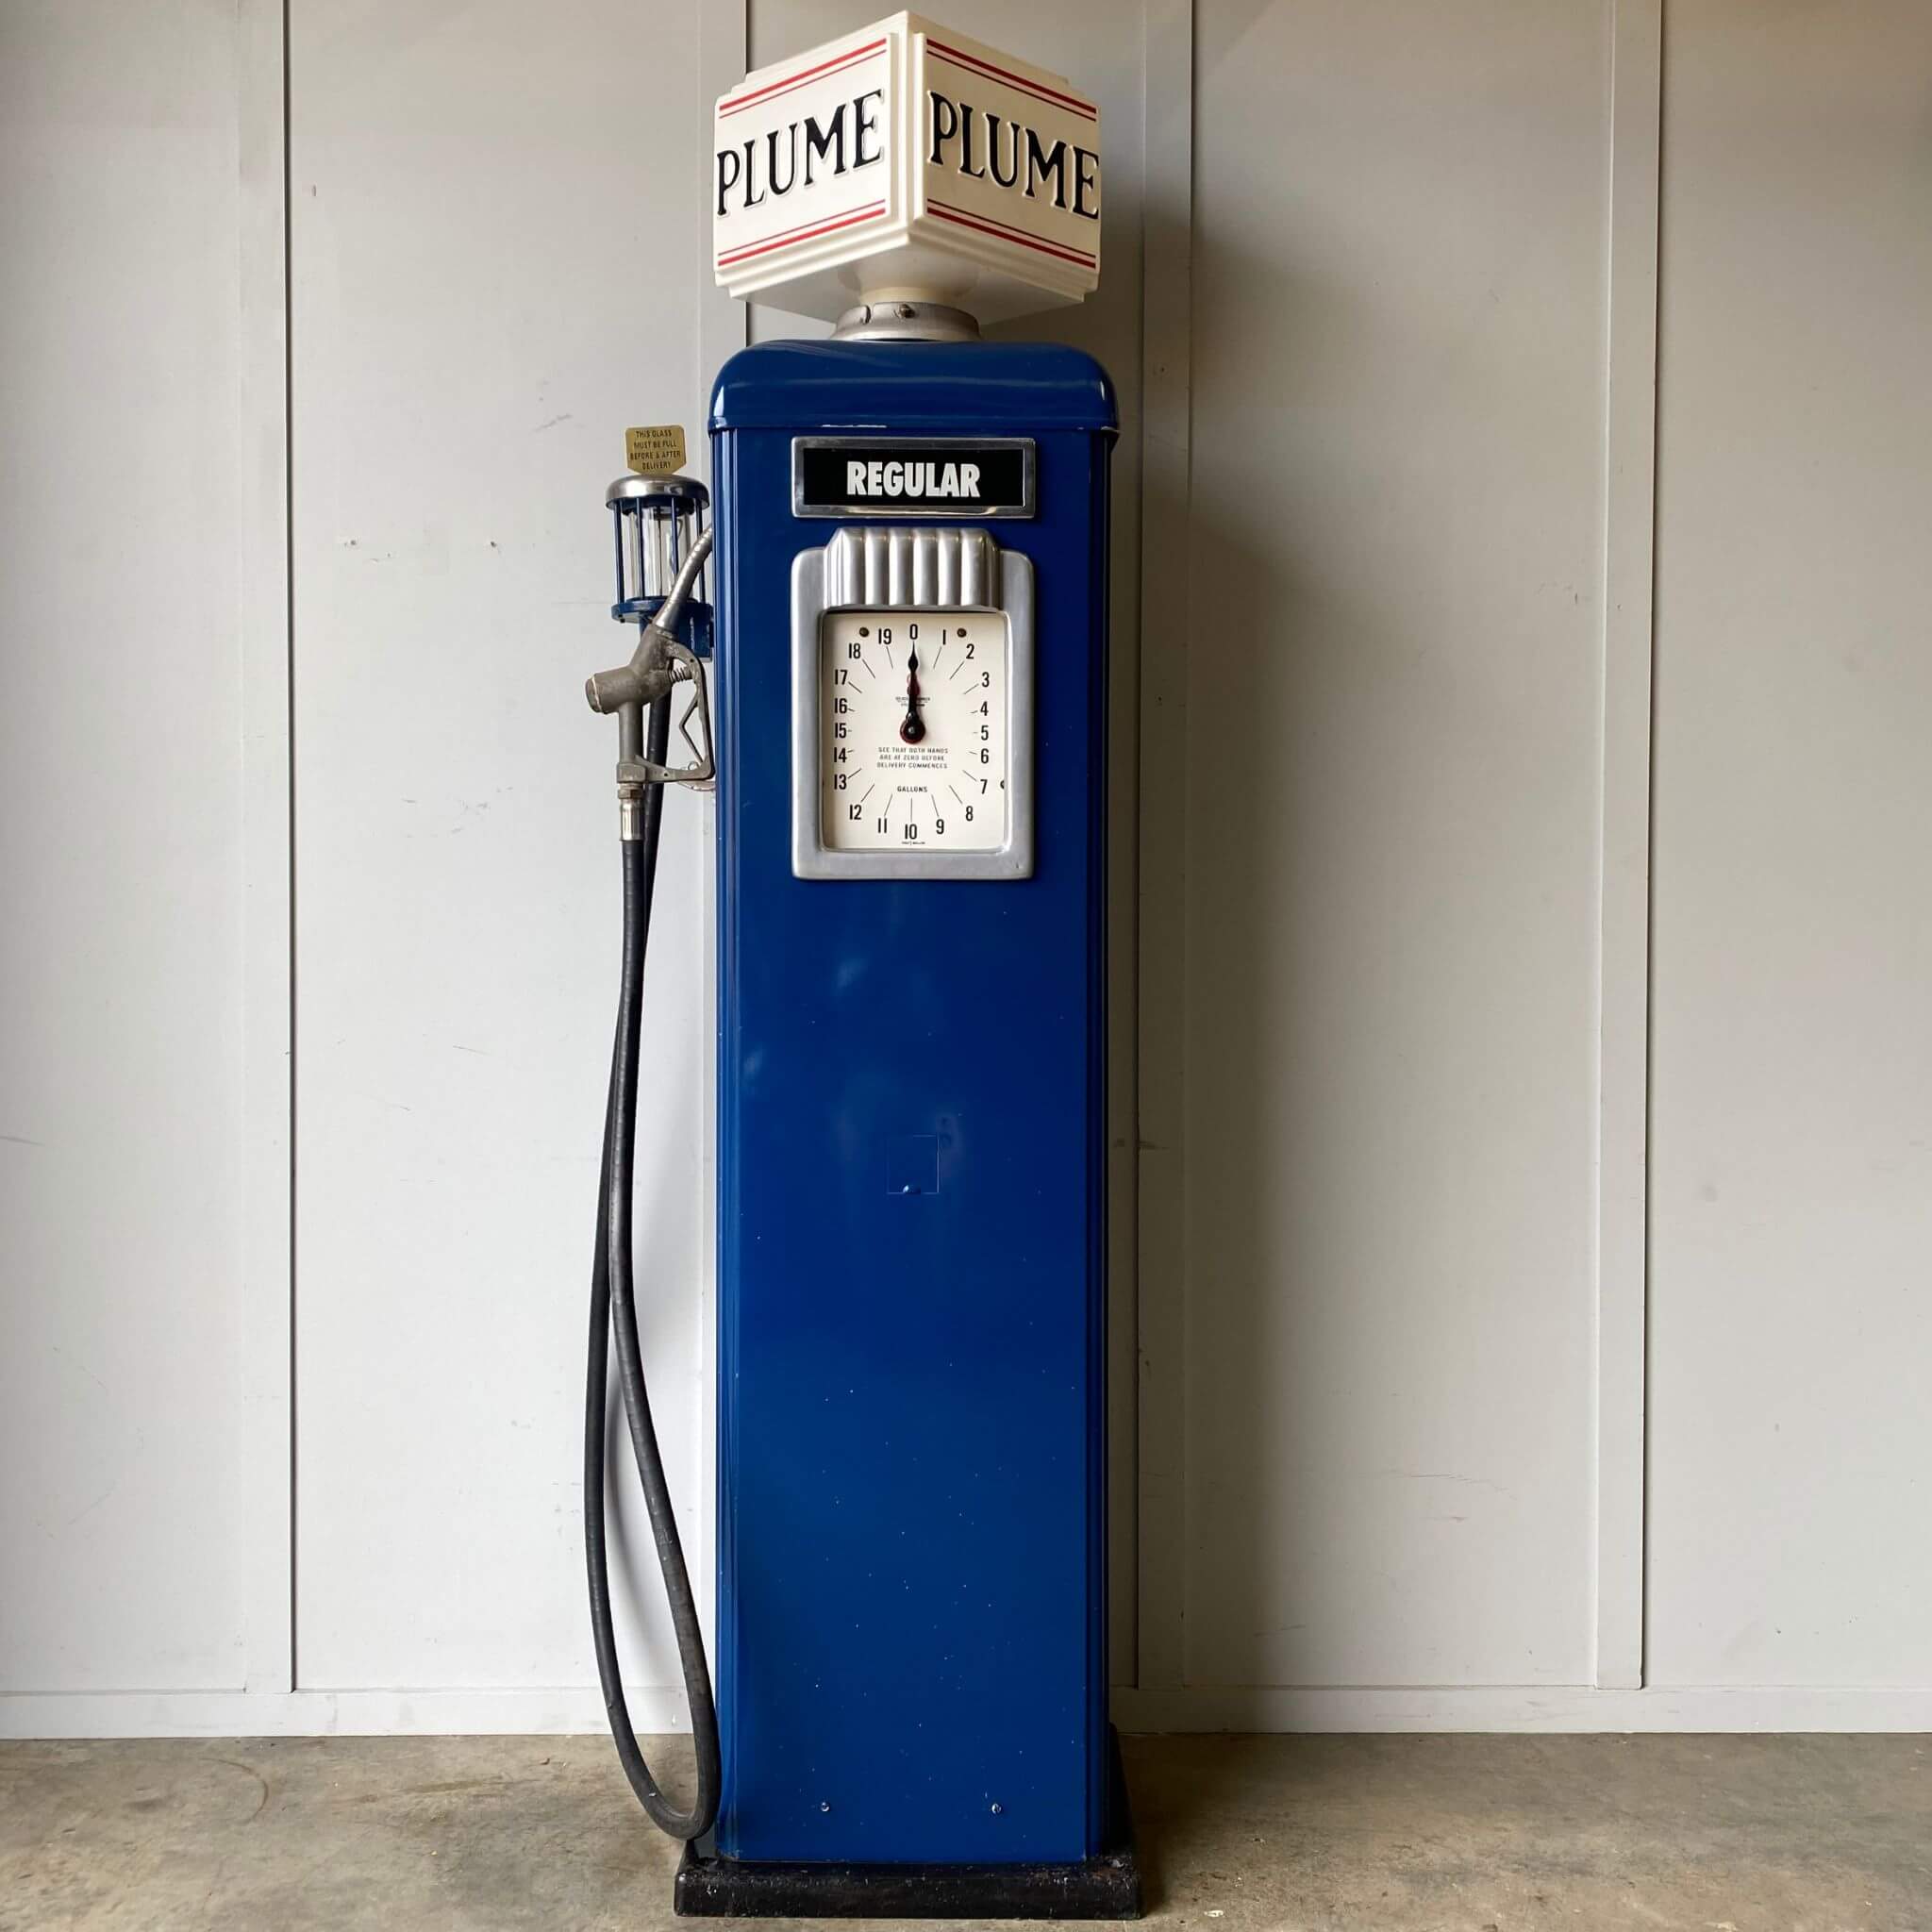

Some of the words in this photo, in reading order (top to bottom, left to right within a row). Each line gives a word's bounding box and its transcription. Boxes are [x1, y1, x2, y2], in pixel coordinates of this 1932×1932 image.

[716, 89, 883, 216] PLUME
[927, 91, 1100, 220] PLUME
[653, 429, 672, 438] GLASS
[634, 441, 651, 449] MUST
[630, 452, 654, 460] BEFORE
[662, 450, 681, 458] AFTER
[642, 461, 672, 470] DELIVERY
[847, 461, 981, 498] REGULAR
[878, 628, 892, 645] 19
[909, 624, 918, 640] 0
[942, 629, 946, 645] 1
[849, 642, 861, 659] 18
[966, 643, 974, 659] 2
[835, 669, 848, 685] 17
[981, 672, 990, 688] 3
[834, 697, 848, 714] 16
[980, 701, 989, 716] 4
[835, 723, 847, 739] 15
[980, 725, 989, 741] 5
[834, 747, 847, 762] 14
[981, 748, 989, 764] 6
[834, 774, 847, 790] 13
[980, 779, 988, 794] 7
[849, 805, 862, 820] 12
[965, 806, 974, 822] 8
[877, 818, 888, 834] 11
[905, 824, 917, 840] 10
[936, 819, 944, 835] 9
